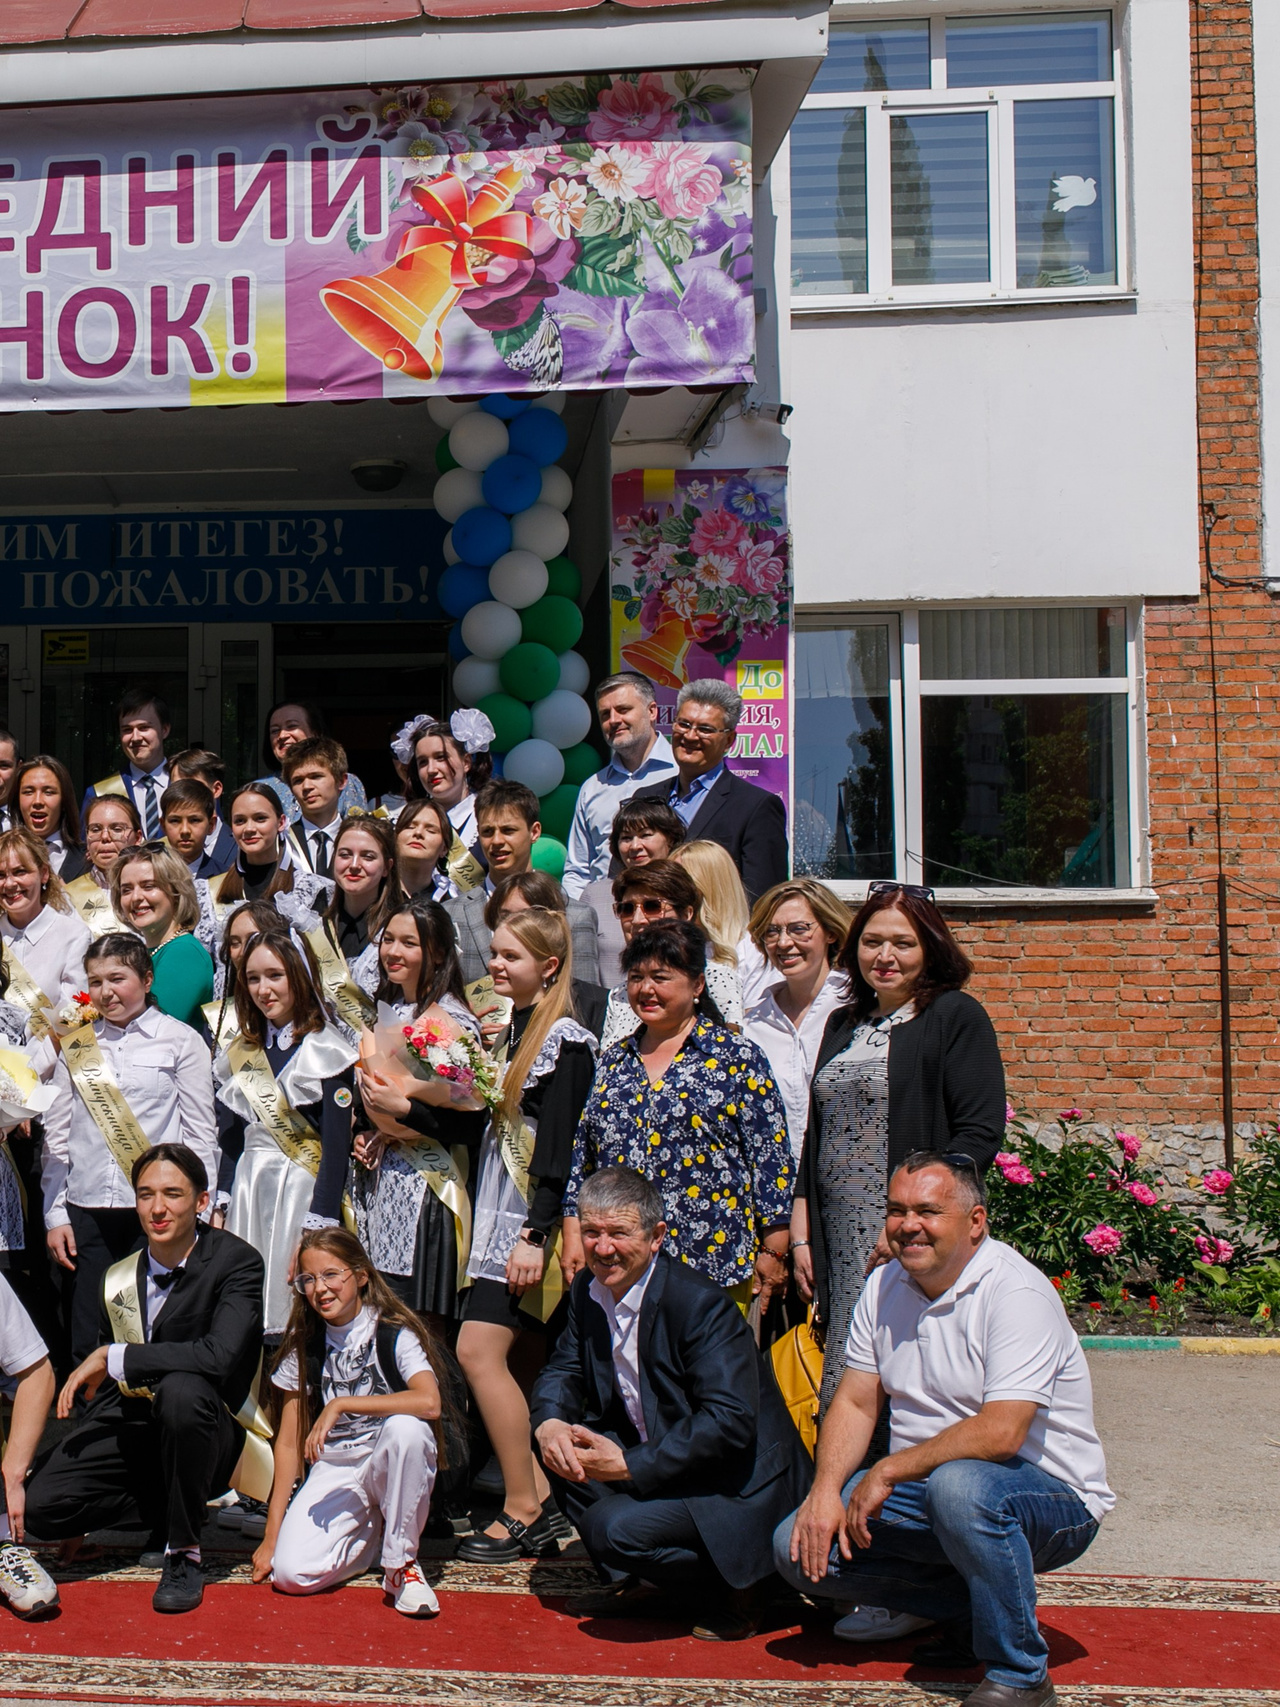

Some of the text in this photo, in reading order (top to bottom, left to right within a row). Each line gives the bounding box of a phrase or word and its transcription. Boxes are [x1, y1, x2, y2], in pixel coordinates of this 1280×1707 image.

[20, 565, 430, 608] ПОЖАЛОВАТЬ!
[738, 664, 783, 695] До
[80, 1058, 135, 1153] Выпускница
[411, 1141, 458, 1184] 2023
